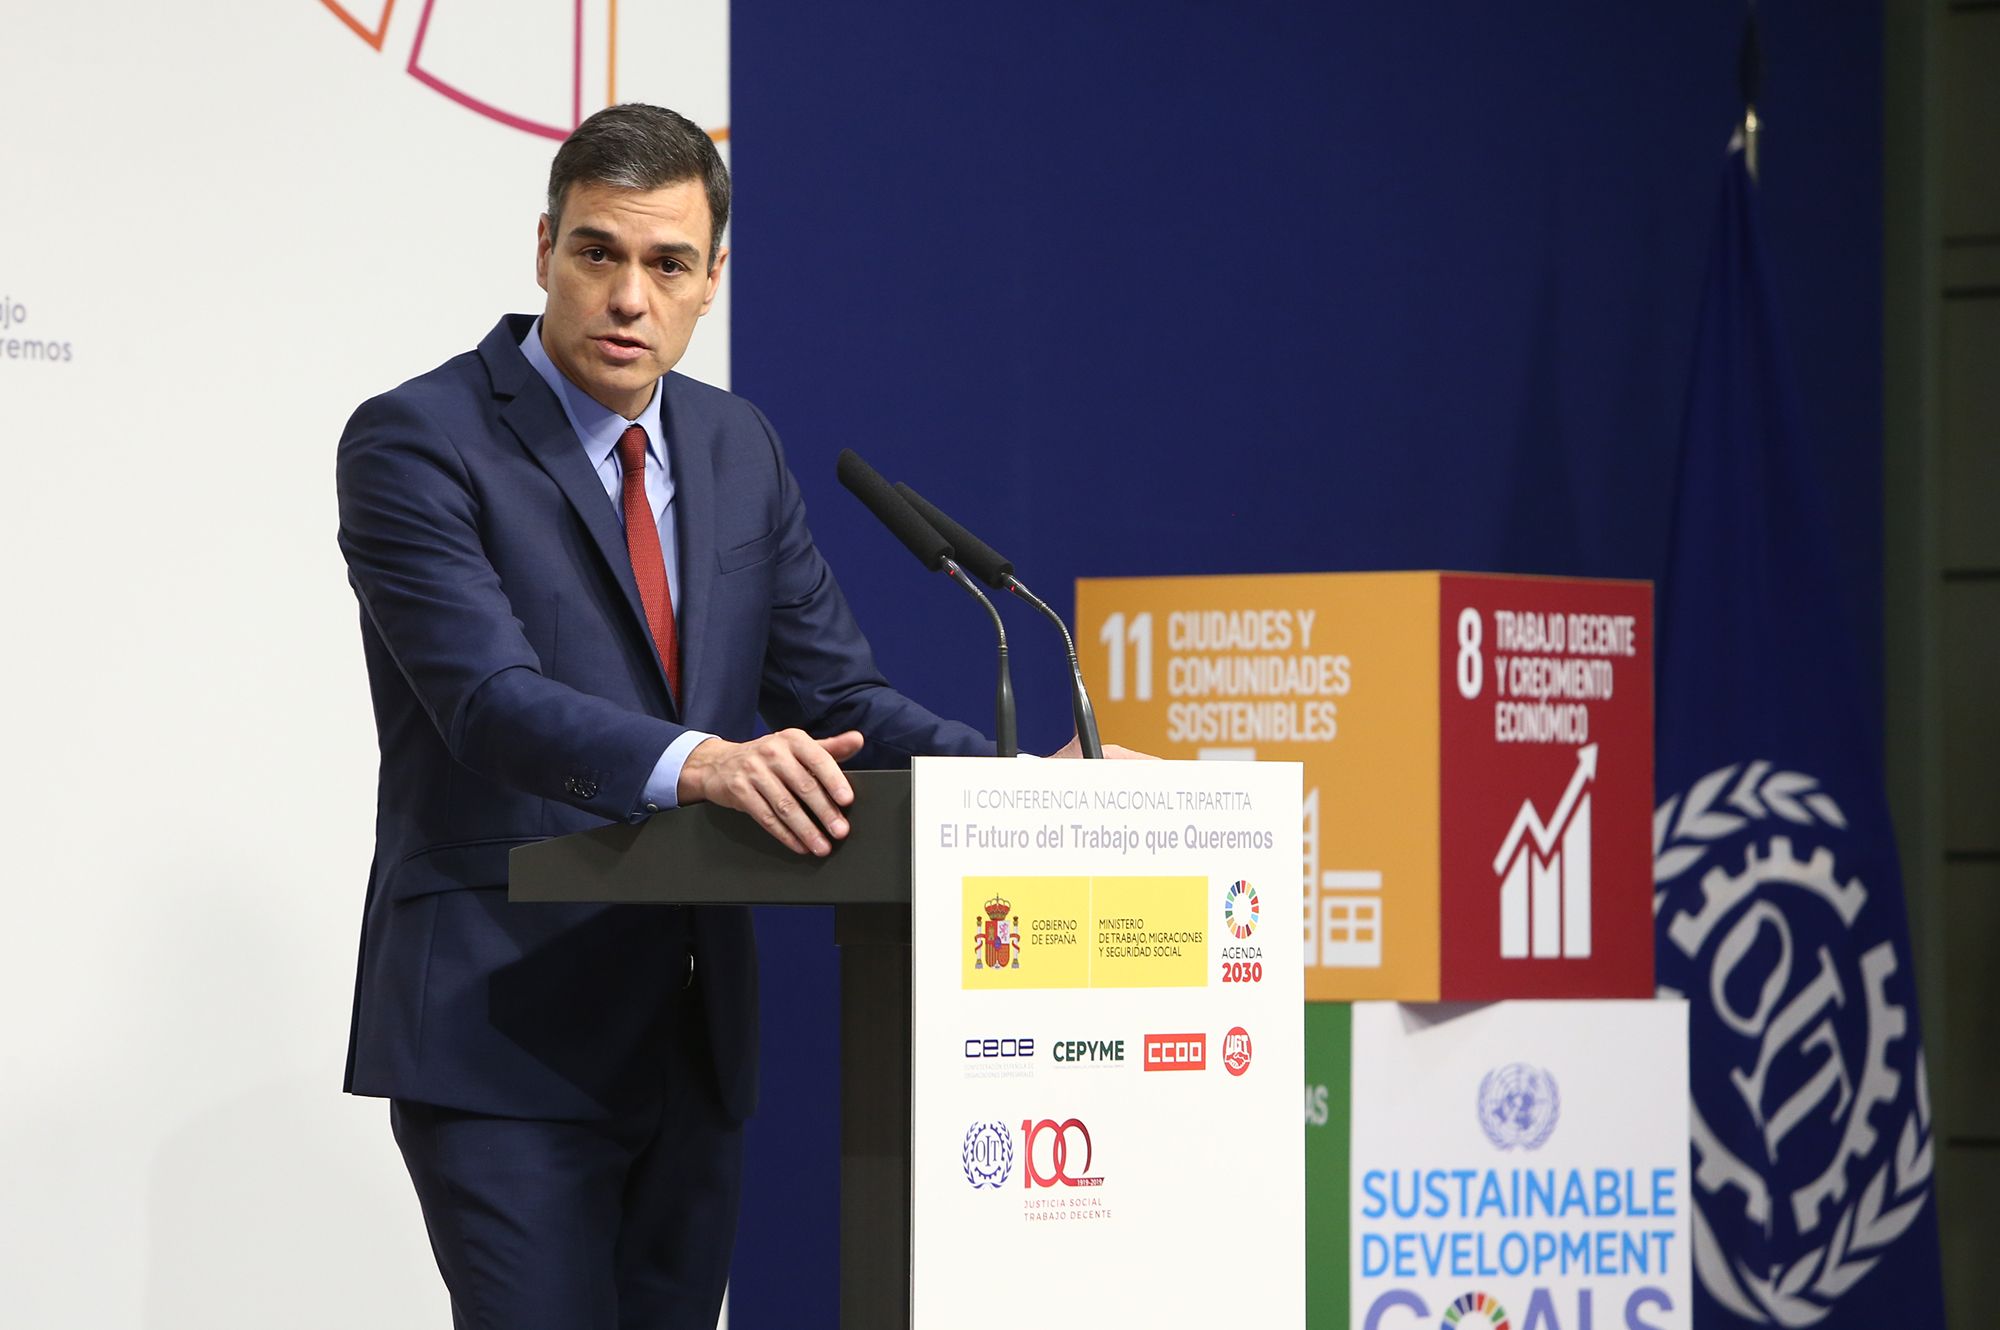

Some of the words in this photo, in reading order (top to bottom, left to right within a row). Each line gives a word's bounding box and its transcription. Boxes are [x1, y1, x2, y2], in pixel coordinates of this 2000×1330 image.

[1168, 609, 1293, 650] CIUDADES
[1297, 608, 1316, 650] Y
[1494, 610, 1566, 653] TRABAJO
[1567, 613, 1636, 657] DECENTE
[1100, 611, 1153, 700] 11
[1456, 606, 1484, 700] 8
[1167, 655, 1351, 696] COMUNIDADES
[1494, 656, 1507, 696] Y
[1509, 656, 1614, 700] CRECIMIENTO
[1167, 701, 1338, 742] SOSTENIBLES
[1494, 694, 1589, 744] ECONÓMICO
[963, 789, 971, 809] II
[976, 789, 1090, 810] CONFERENCIA
[1094, 790, 1174, 810] NACIONAL
[1176, 791, 1252, 811] TRIPARTITA
[940, 823, 958, 849] El
[965, 824, 1029, 849] Futuro
[1036, 823, 1064, 849] del
[1070, 824, 1139, 855] Trabajo
[1145, 828, 1179, 855] que
[1184, 824, 1273, 850] Queremos
[1032, 919, 1077, 931] GOBIERNO
[1099, 918, 1144, 930] MINISTERIO
[1032, 934, 1043, 945] DE
[1045, 931, 1077, 945] ESPAÑA
[1099, 932, 1110, 944] DE
[1111, 932, 1148, 946] TRABAJO,
[1149, 932, 1202, 943] MIGRACIONES
[1106, 946, 1151, 958] SEGURIDAD
[1153, 946, 1182, 957] SOCIAL
[1222, 947, 1262, 959] AGENDA
[1222, 962, 1263, 983] 2030
[1053, 1040, 1124, 1062] CEPYME
[1148, 1041, 1202, 1063] CCOO
[1225, 1034, 1249, 1055] UGT
[975, 1135, 1000, 1167] OIT
[1024, 1199, 1066, 1209] JUSTICIA
[1069, 1197, 1102, 1207] SOCIAL
[1362, 1168, 1677, 1218] SUSTAINABLE
[1024, 1211, 1066, 1221] TRABAJO
[1070, 1209, 1111, 1220] DECENTE
[1362, 1231, 1675, 1277] DEVELOPMENT
